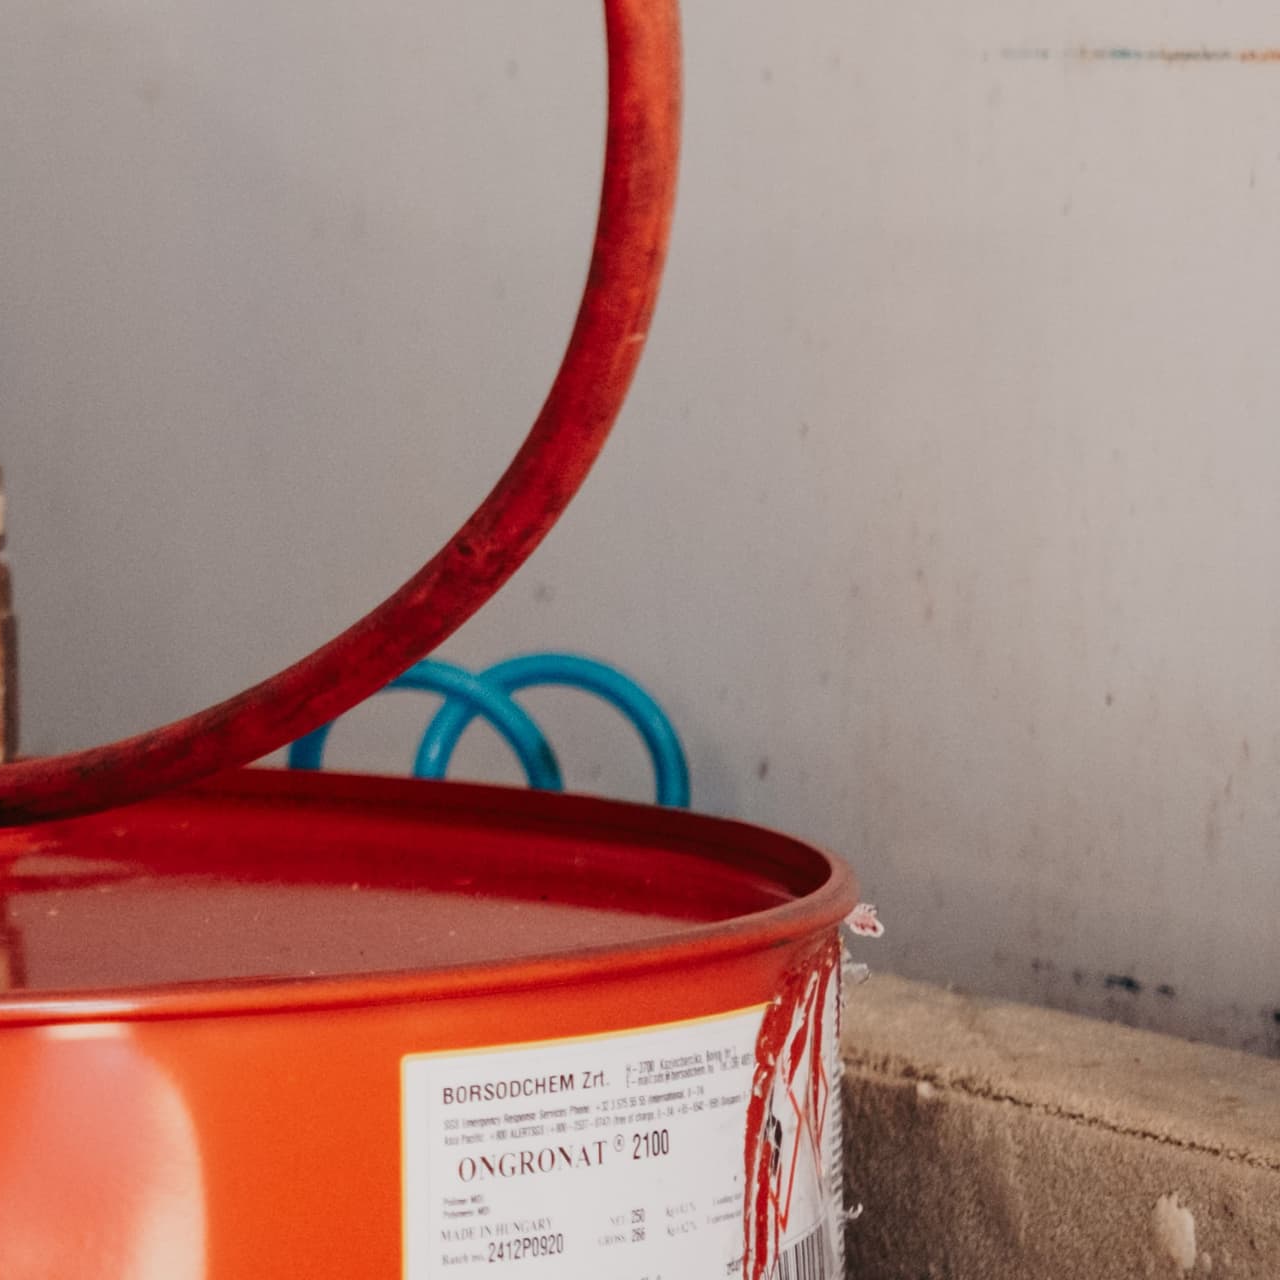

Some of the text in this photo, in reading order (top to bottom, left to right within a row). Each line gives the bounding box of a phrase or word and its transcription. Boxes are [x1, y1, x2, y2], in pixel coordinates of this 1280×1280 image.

[443, 1073, 575, 1105] BORSODCHEM
[582, 1070, 611, 1090] Zrt.
[458, 1128, 670, 1182] ONGRONAT 2100
[441, 1227, 474, 1242] MADE
[496, 1217, 552, 1237] HUNGARY
[488, 1233, 564, 1263] 2412P0920
